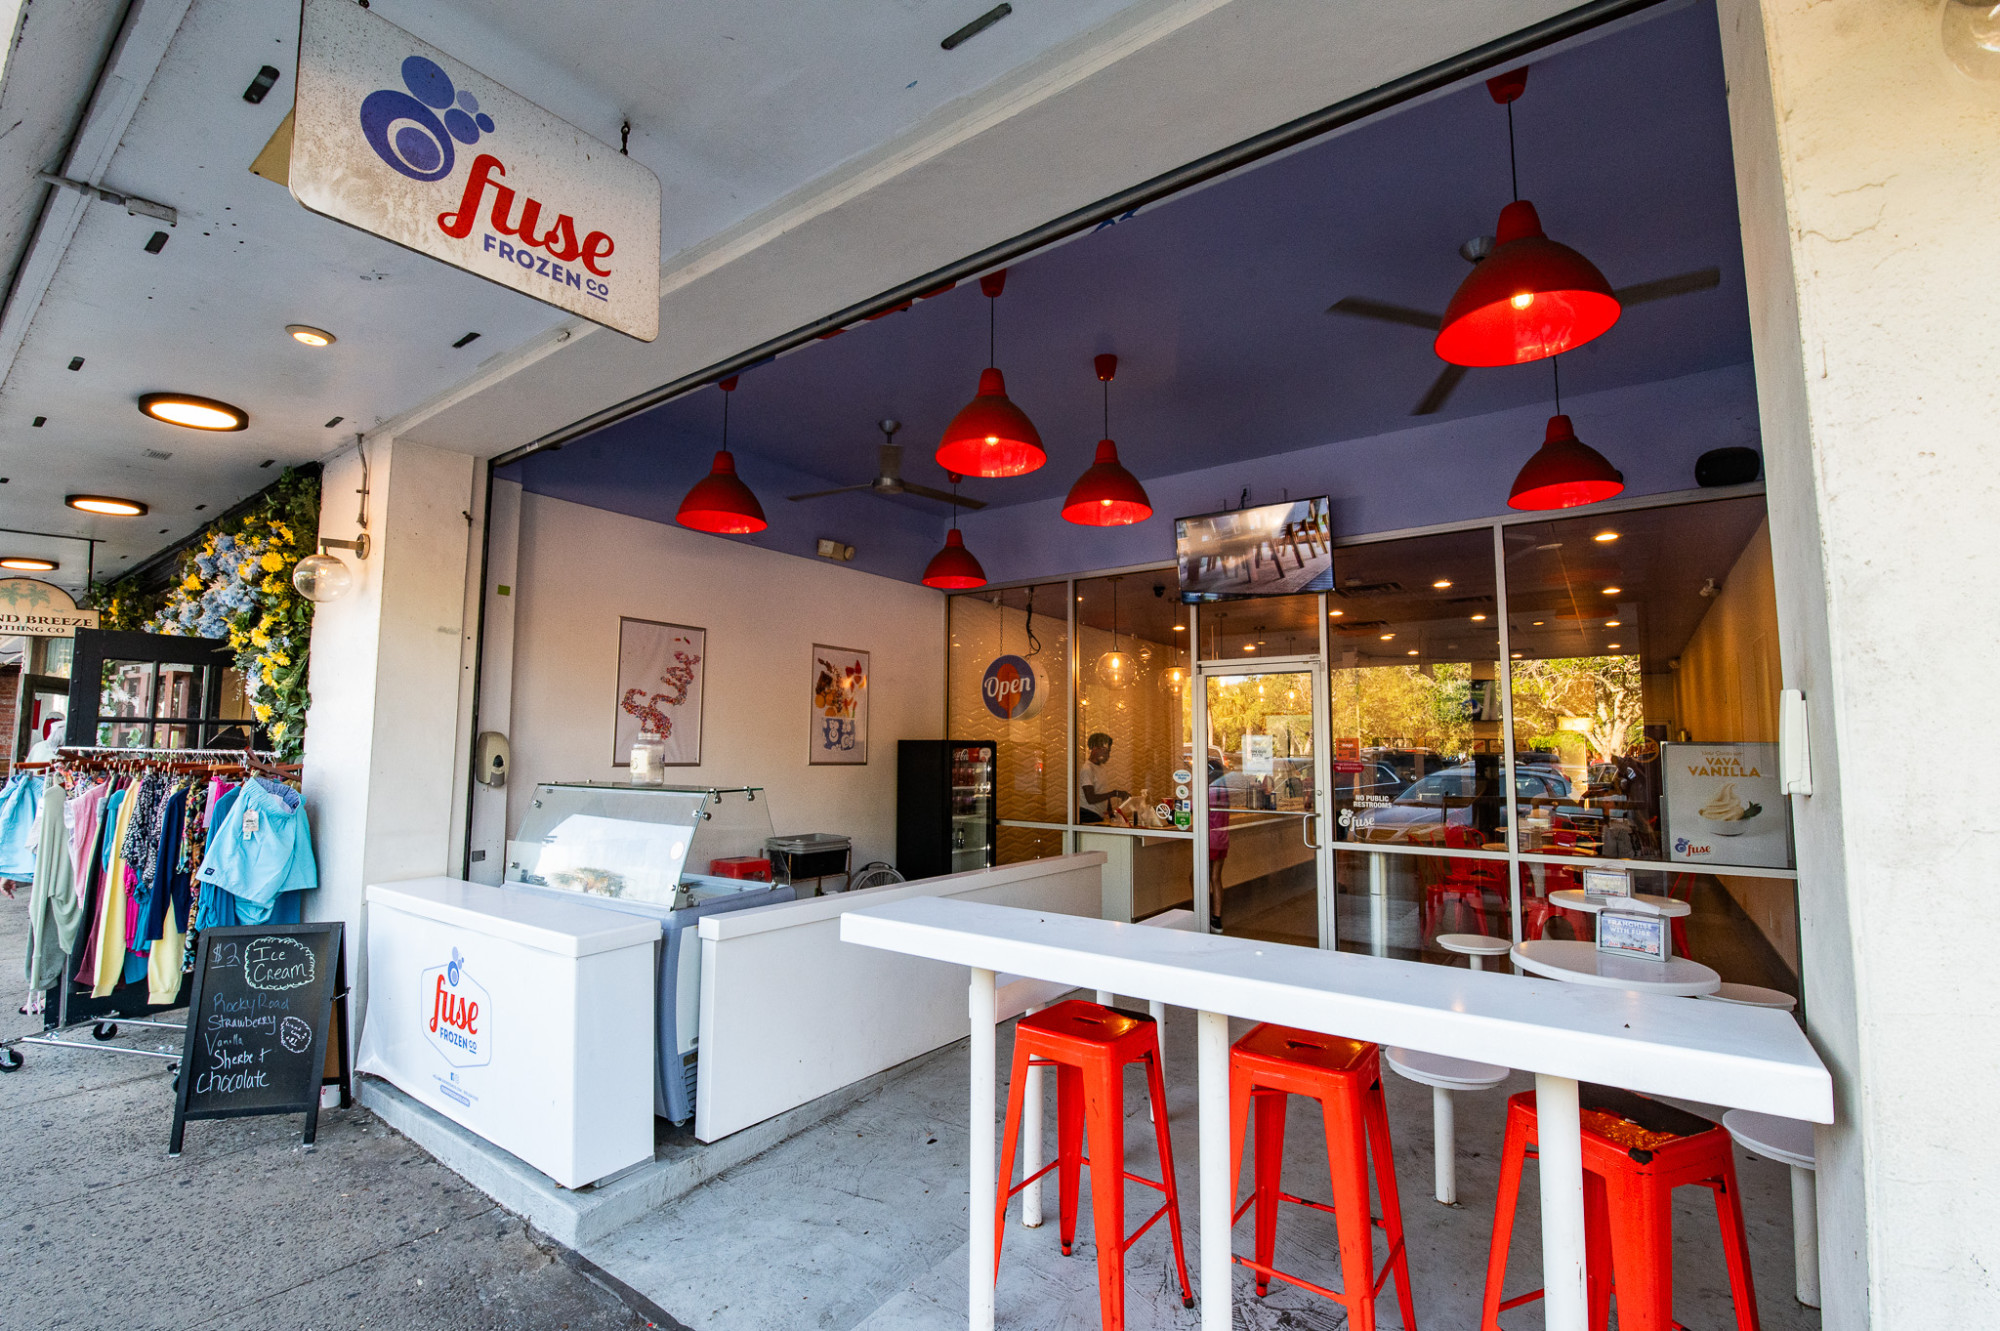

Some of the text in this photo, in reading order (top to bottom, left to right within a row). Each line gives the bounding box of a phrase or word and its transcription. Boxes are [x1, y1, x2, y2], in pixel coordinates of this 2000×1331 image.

[437, 154, 614, 277] fuse
[484, 234, 581, 290] FROZEN
[26, 616, 93, 627] BREEZE
[984, 676, 1031, 702] Open
[1688, 766, 1761, 778] VANILLA
[1706, 757, 1740, 766] VAVA
[1350, 816, 1375, 831] fuse
[1686, 844, 1711, 857] fuse
[1608, 920, 1651, 928] FRANCHISE
[1610, 927, 1629, 935] WITH
[211, 943, 286, 967] $2 Ice
[214, 993, 289, 1016] Rocky Road
[429, 974, 478, 1035] fuse
[205, 1031, 243, 1056] Vanilla
[440, 1027, 468, 1050] FROZEN
